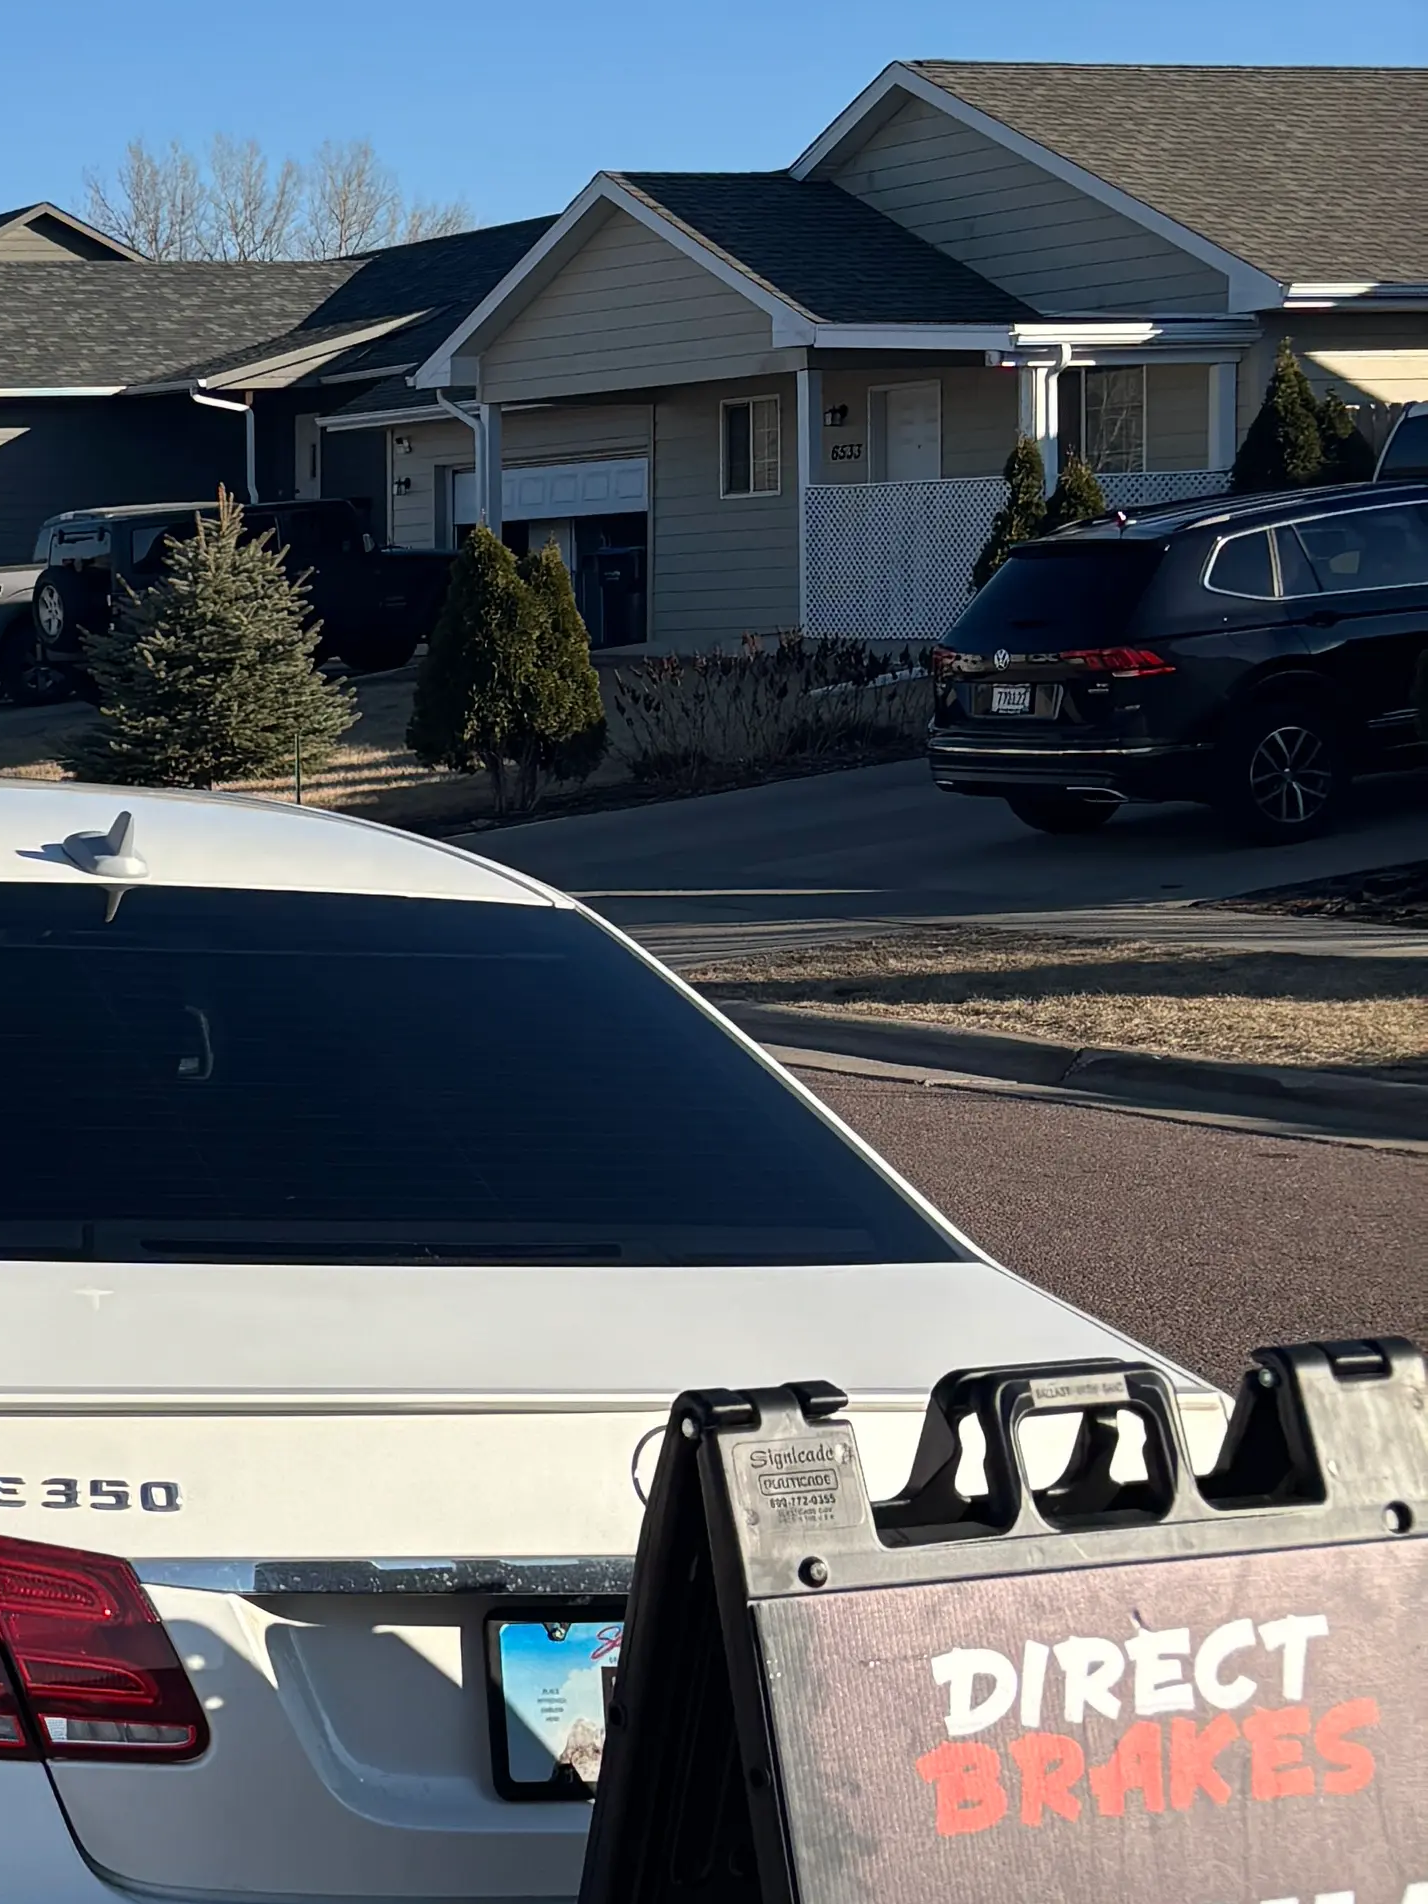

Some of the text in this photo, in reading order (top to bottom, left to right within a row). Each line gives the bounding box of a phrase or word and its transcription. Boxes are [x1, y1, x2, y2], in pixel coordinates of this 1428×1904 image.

[831, 443, 863, 461] 6533
[41, 1478, 184, 1512] 350
[930, 1613, 1329, 1737] DIRECT
[915, 1696, 1381, 1837] BRAKES
